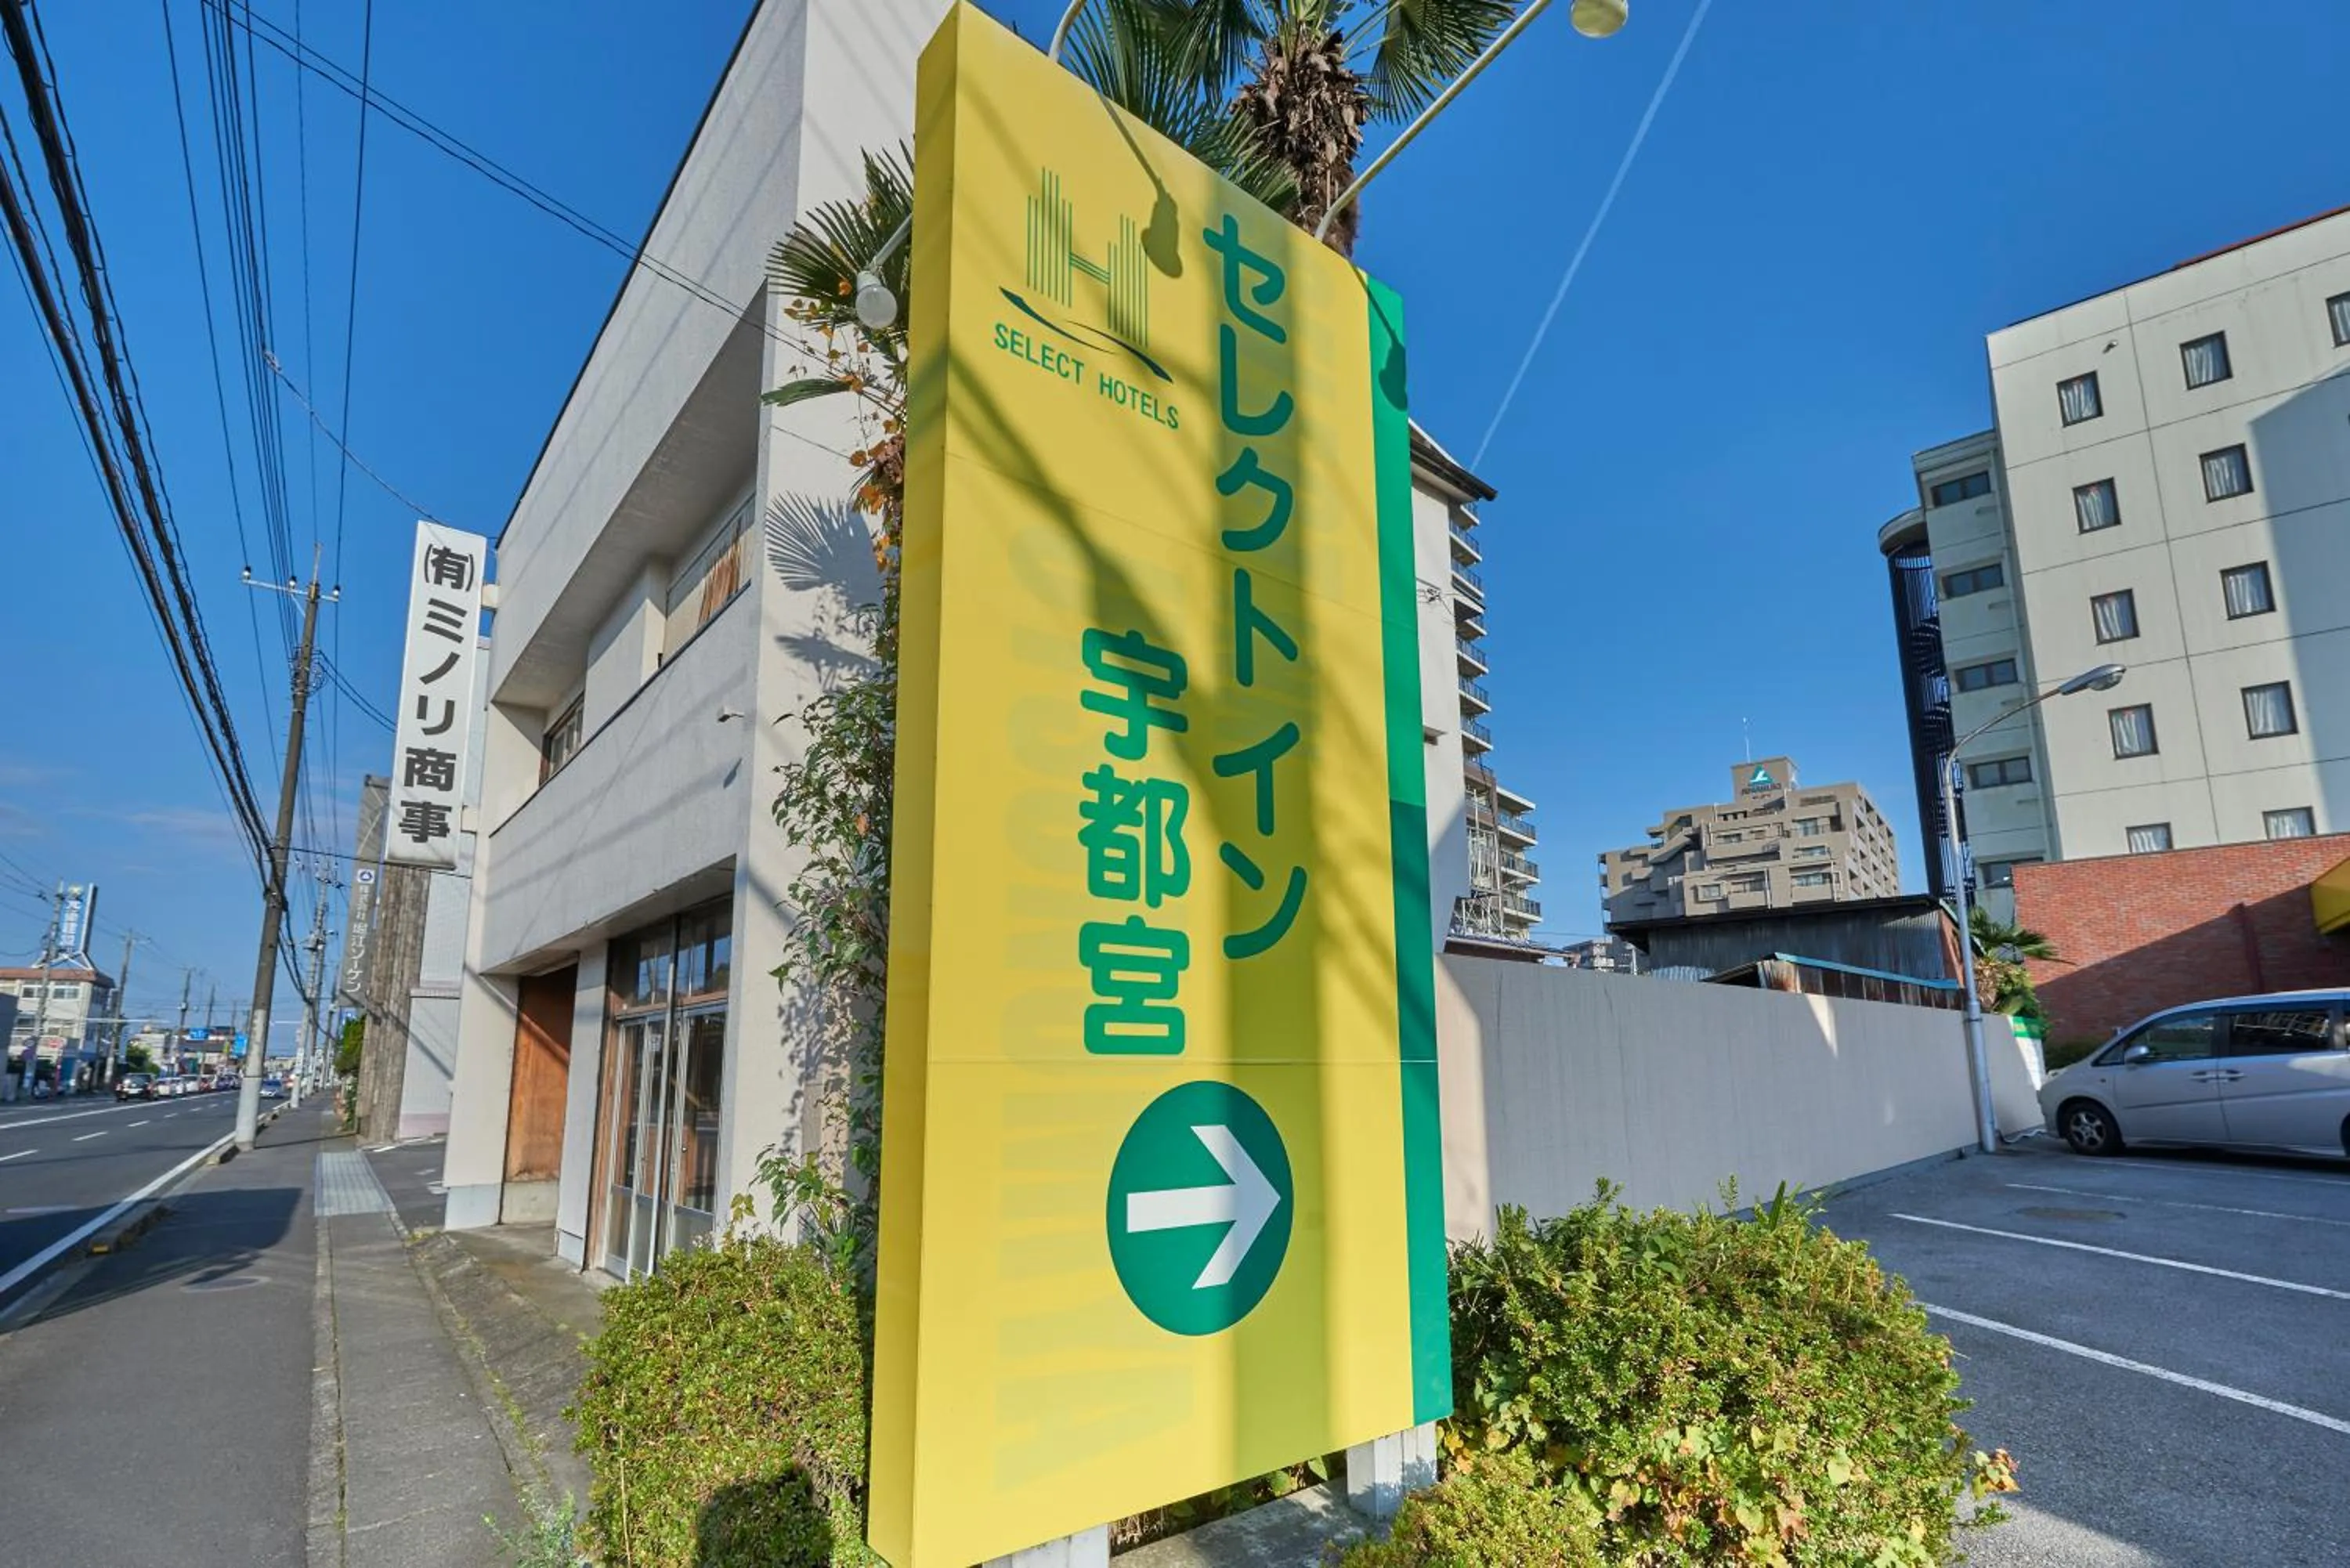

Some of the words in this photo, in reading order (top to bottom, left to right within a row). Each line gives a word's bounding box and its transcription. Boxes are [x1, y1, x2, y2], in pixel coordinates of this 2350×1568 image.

[994, 323, 1085, 385] SELECT
[1099, 373, 1180, 430] HOTELS
[1202, 213, 1307, 960] セレクトイン
[1078, 627, 1191, 1056] 宇都宮
